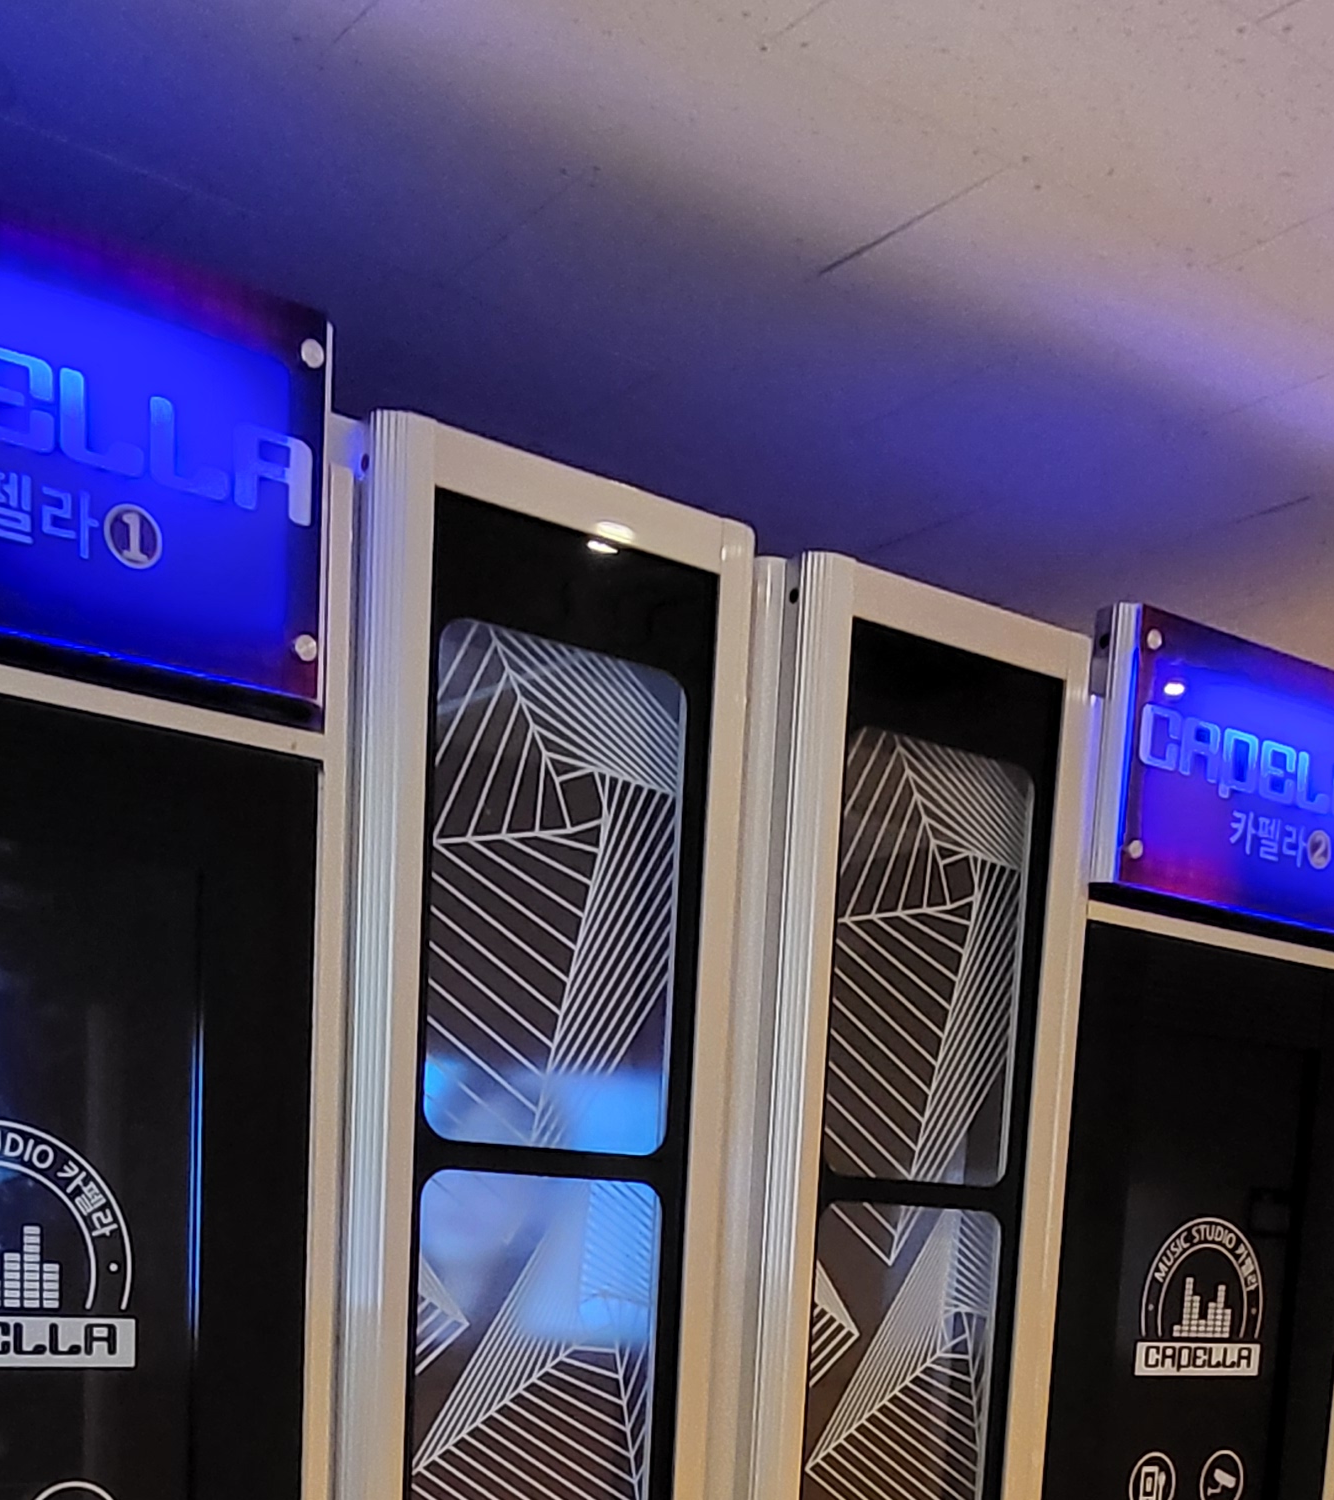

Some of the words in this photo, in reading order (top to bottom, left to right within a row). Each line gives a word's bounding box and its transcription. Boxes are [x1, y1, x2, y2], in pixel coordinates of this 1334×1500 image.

[57, 1160, 118, 1237] 카펠라
[1154, 1231, 1190, 1283] MUSIC
[1191, 1224, 1237, 1249] STUDIO
